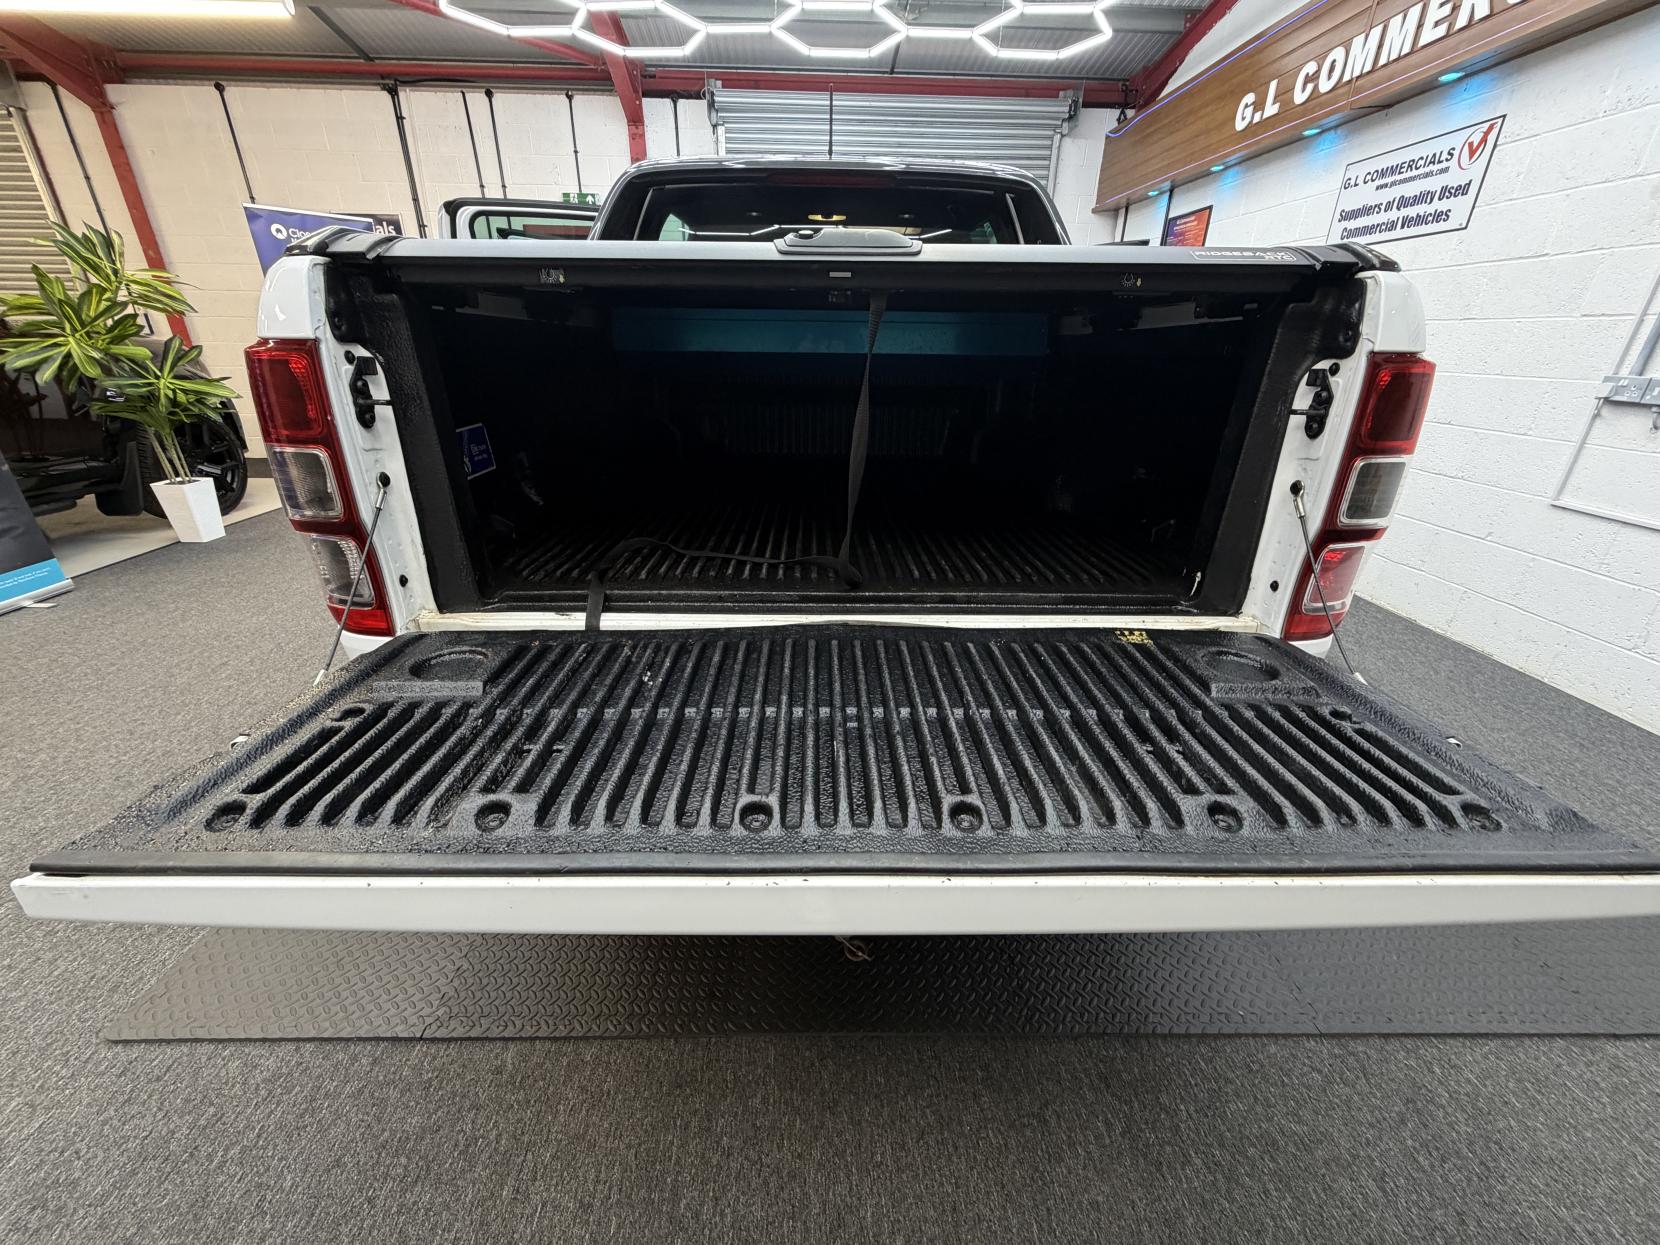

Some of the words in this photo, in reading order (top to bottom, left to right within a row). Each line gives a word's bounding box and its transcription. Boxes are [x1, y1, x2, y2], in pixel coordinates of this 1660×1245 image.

[1234, 79, 1281, 132] G.L
[1293, 0, 1525, 105] COMMER
[1343, 175, 1360, 190] G.L
[1363, 147, 1456, 184] COMMERCIALS
[1375, 165, 1451, 191] www.glcommercials.com
[1338, 202, 1382, 223] Suppliers
[1384, 196, 1395, 212] of
[1396, 187, 1437, 211] Quality
[1437, 179, 1473, 202] Used
[1340, 217, 1399, 241] Commercial
[1400, 208, 1451, 230] Vehicles
